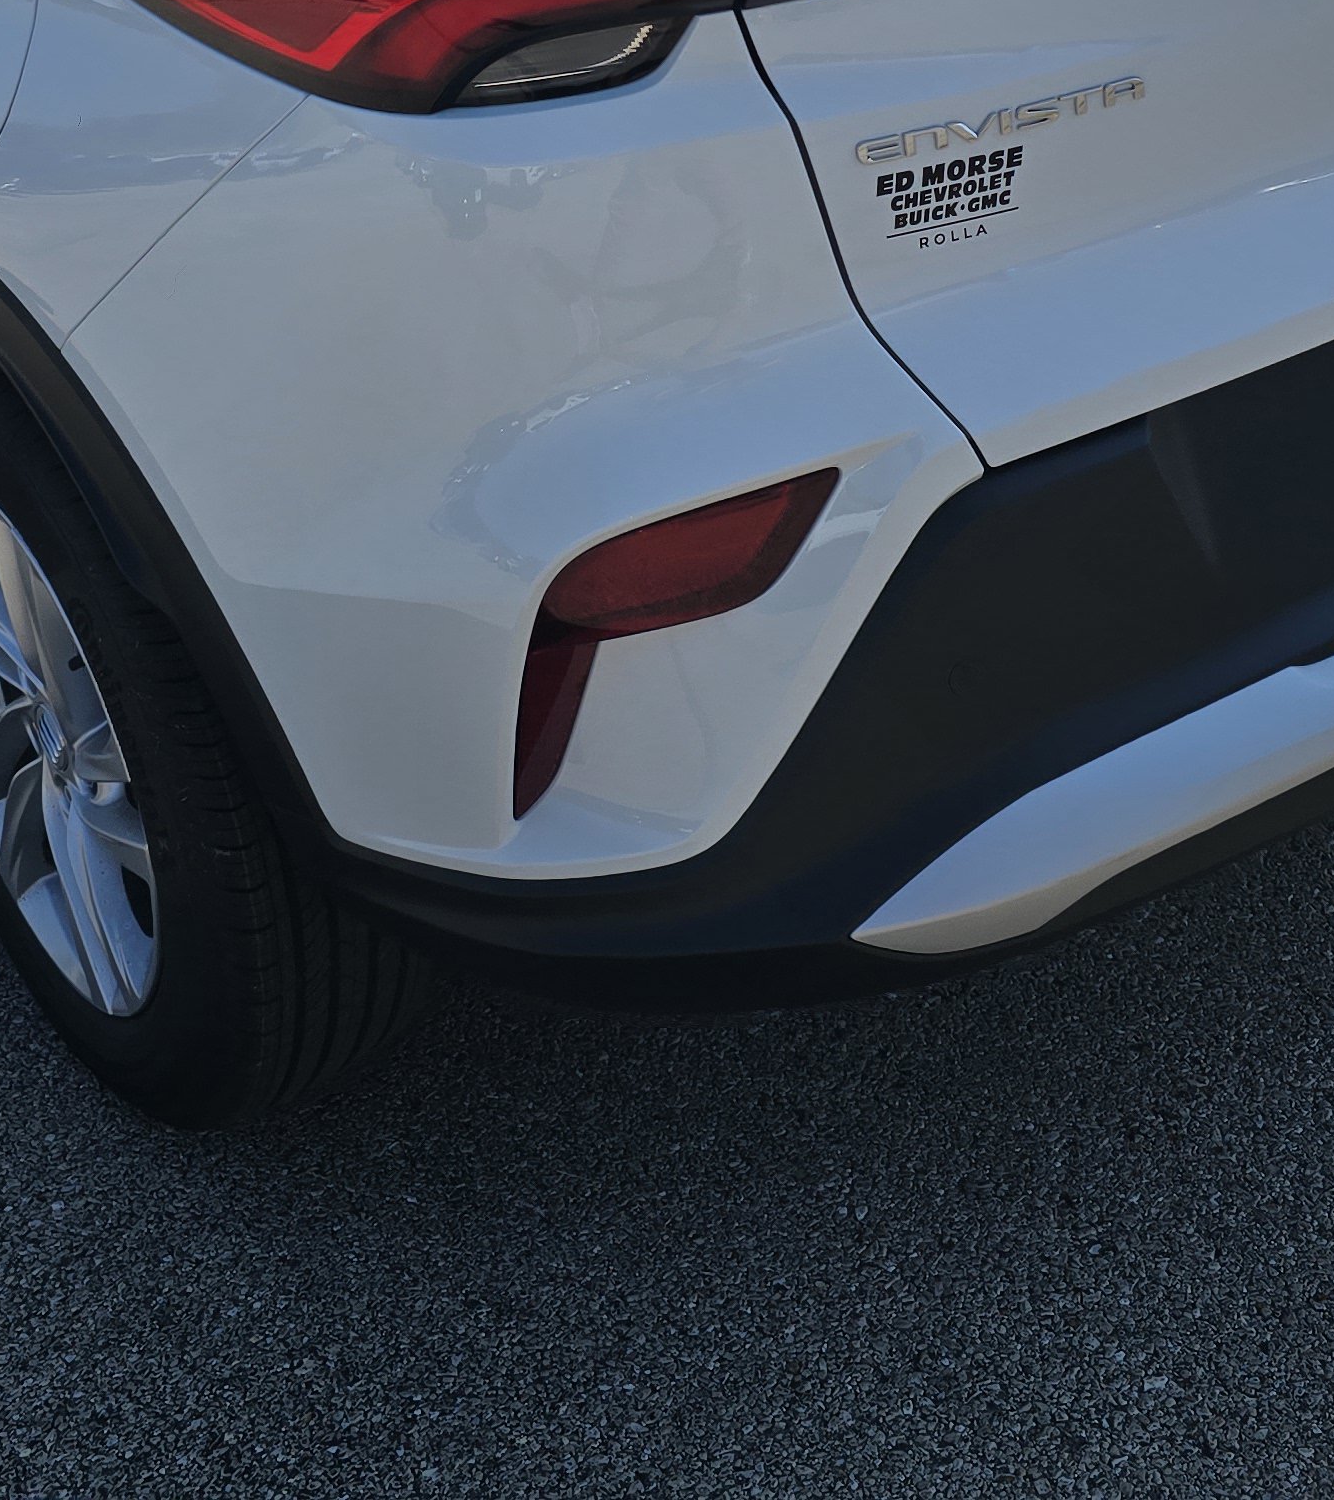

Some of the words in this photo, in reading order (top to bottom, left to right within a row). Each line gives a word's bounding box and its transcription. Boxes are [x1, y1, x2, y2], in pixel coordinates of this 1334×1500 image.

[855, 75, 1147, 166] ENVISTA
[875, 169, 916, 198] ED
[921, 144, 1024, 187] MORSE
[890, 169, 1016, 212] CHEVROLET
[918, 223, 988, 250] ROLLA
